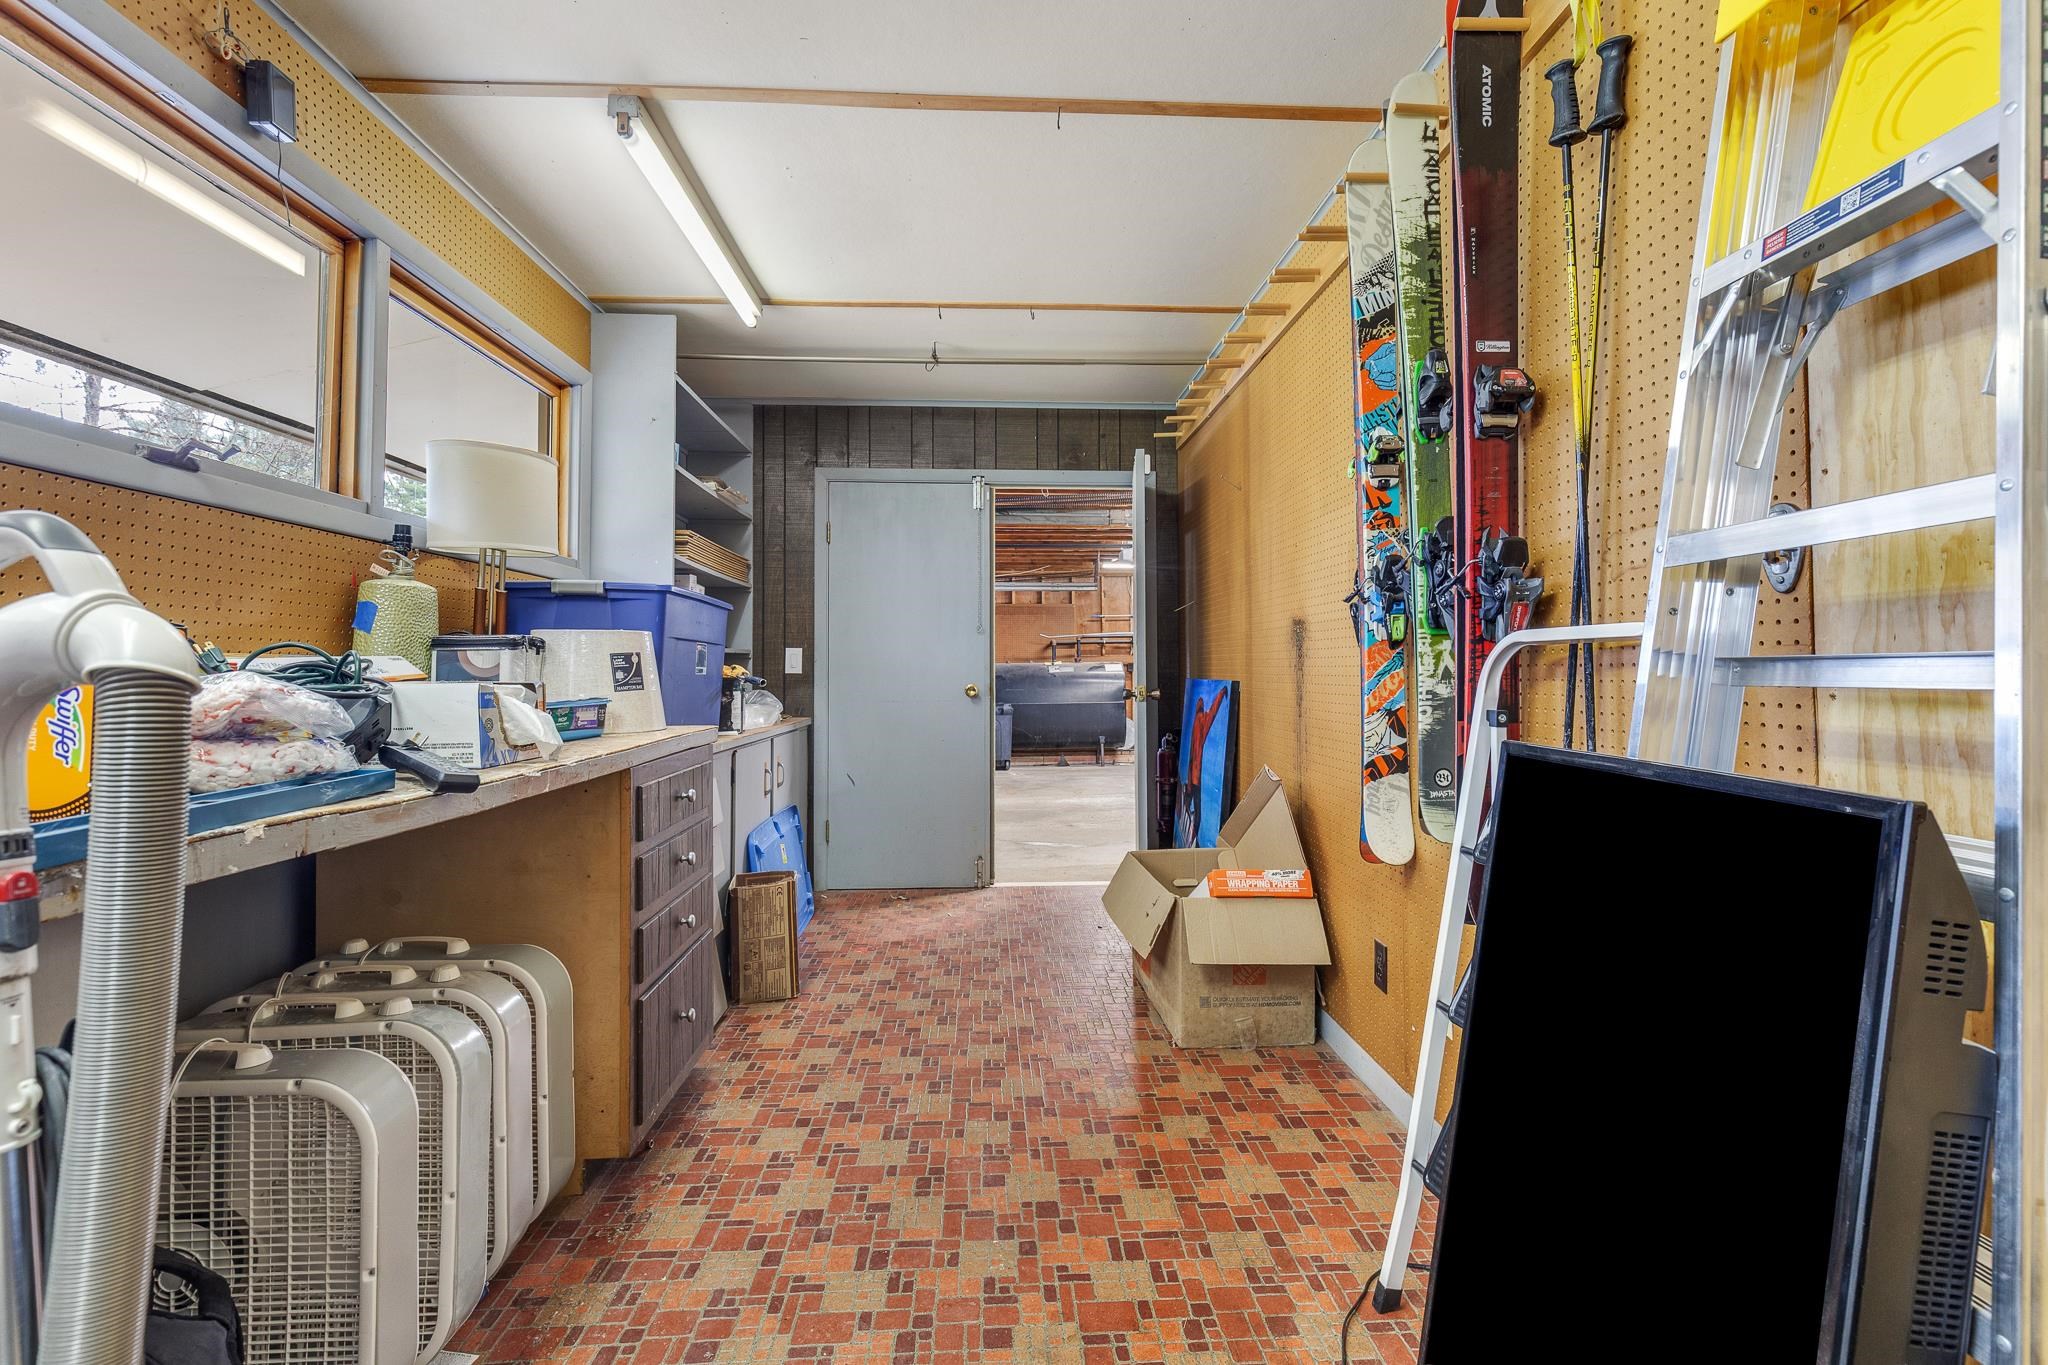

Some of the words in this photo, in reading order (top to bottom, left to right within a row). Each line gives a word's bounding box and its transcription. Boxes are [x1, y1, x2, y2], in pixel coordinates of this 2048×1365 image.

[1482, 64, 1492, 127] ATOMIC
[46, 687, 82, 766] Swiffer
[1226, 879, 1271, 888] WRAPPING
[1272, 880, 1299, 889] PAPER
